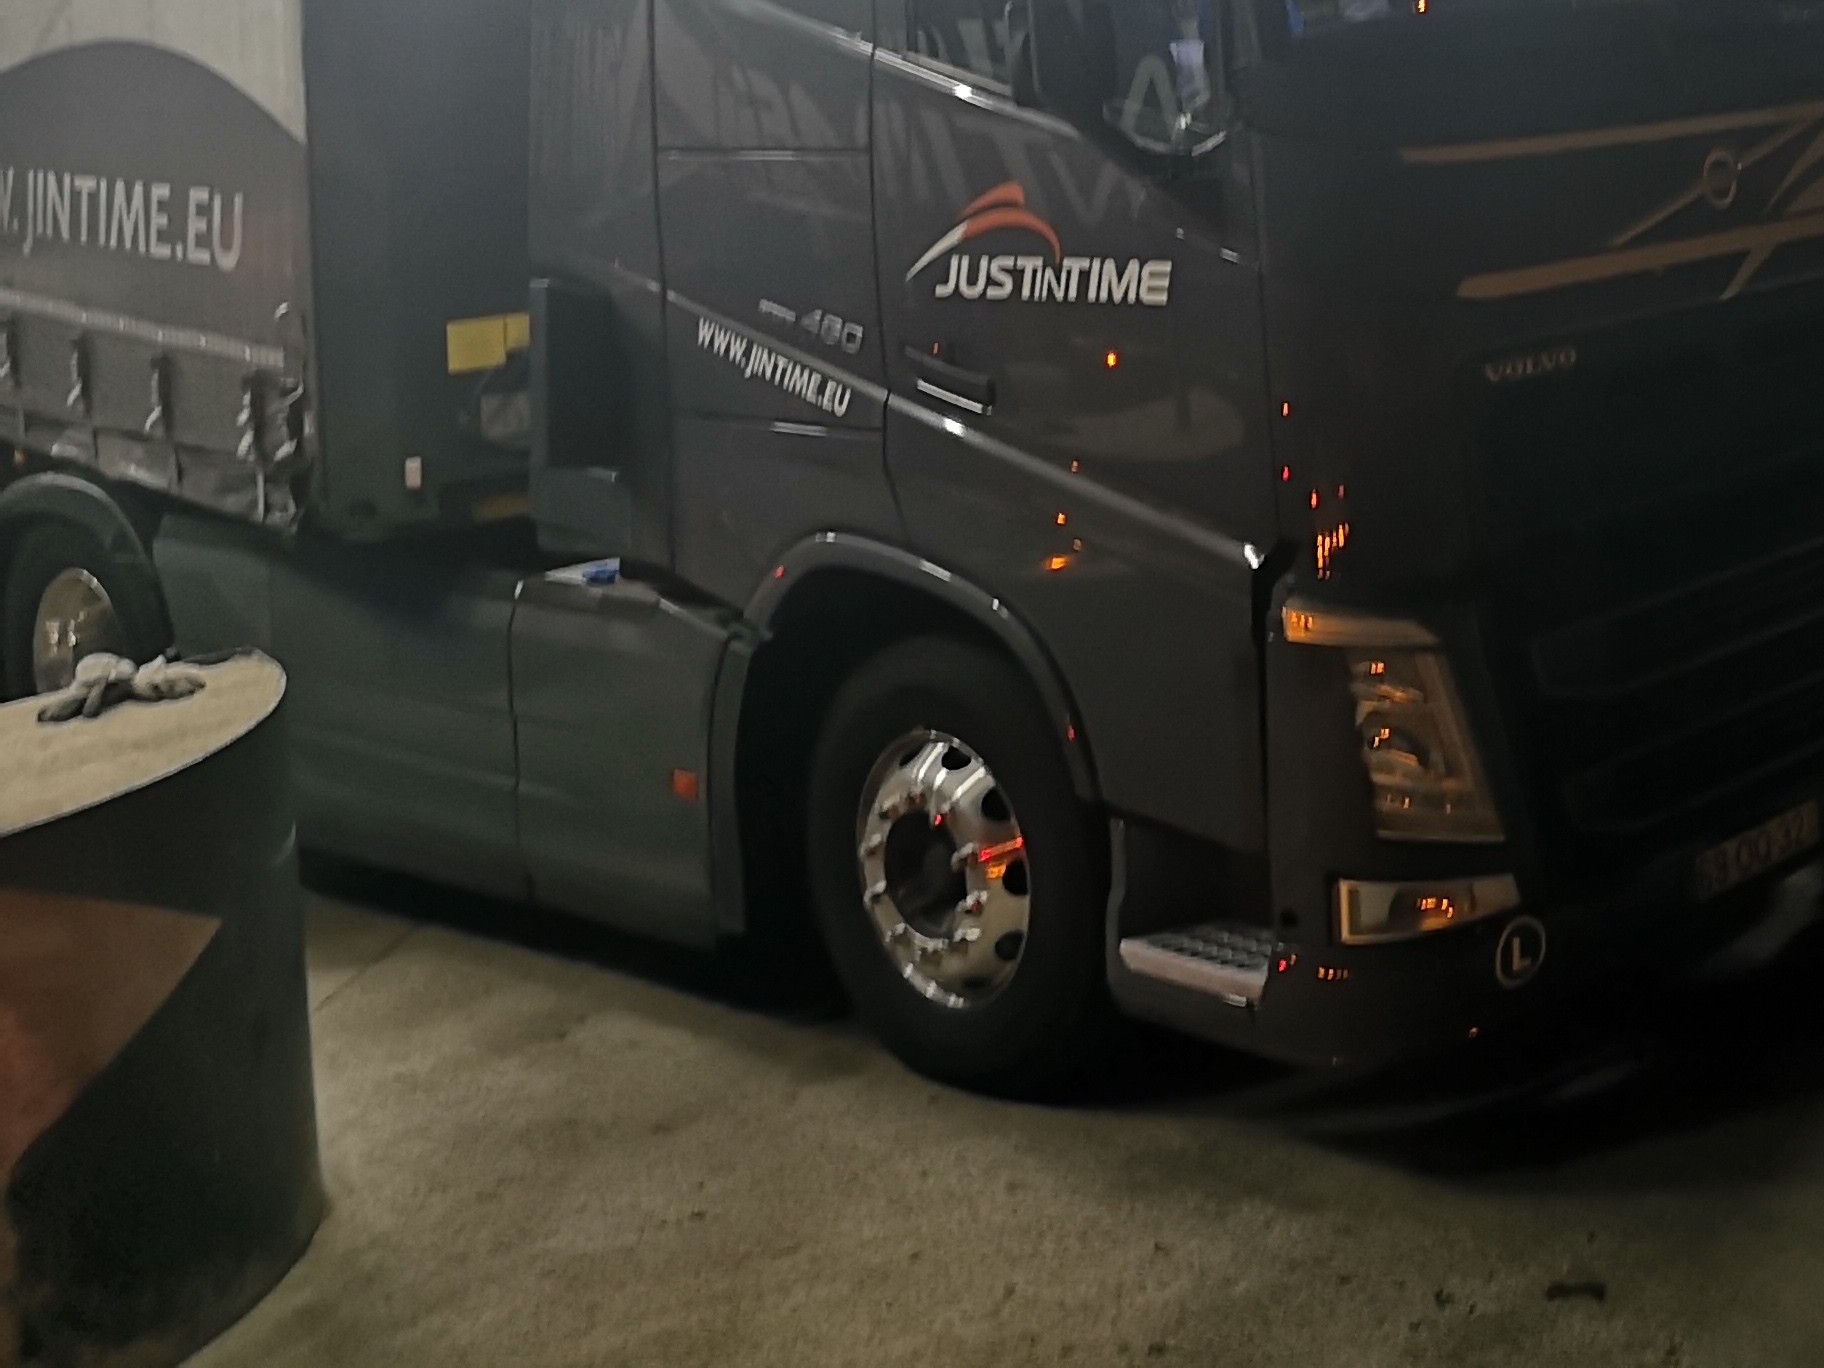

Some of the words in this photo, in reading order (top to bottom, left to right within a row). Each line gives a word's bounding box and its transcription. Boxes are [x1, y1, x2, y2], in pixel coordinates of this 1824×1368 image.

[698, 315, 852, 409] WWW.JINTIME.EU
[1485, 345, 1578, 382] VOLVO
[1511, 935, 1533, 972] L
